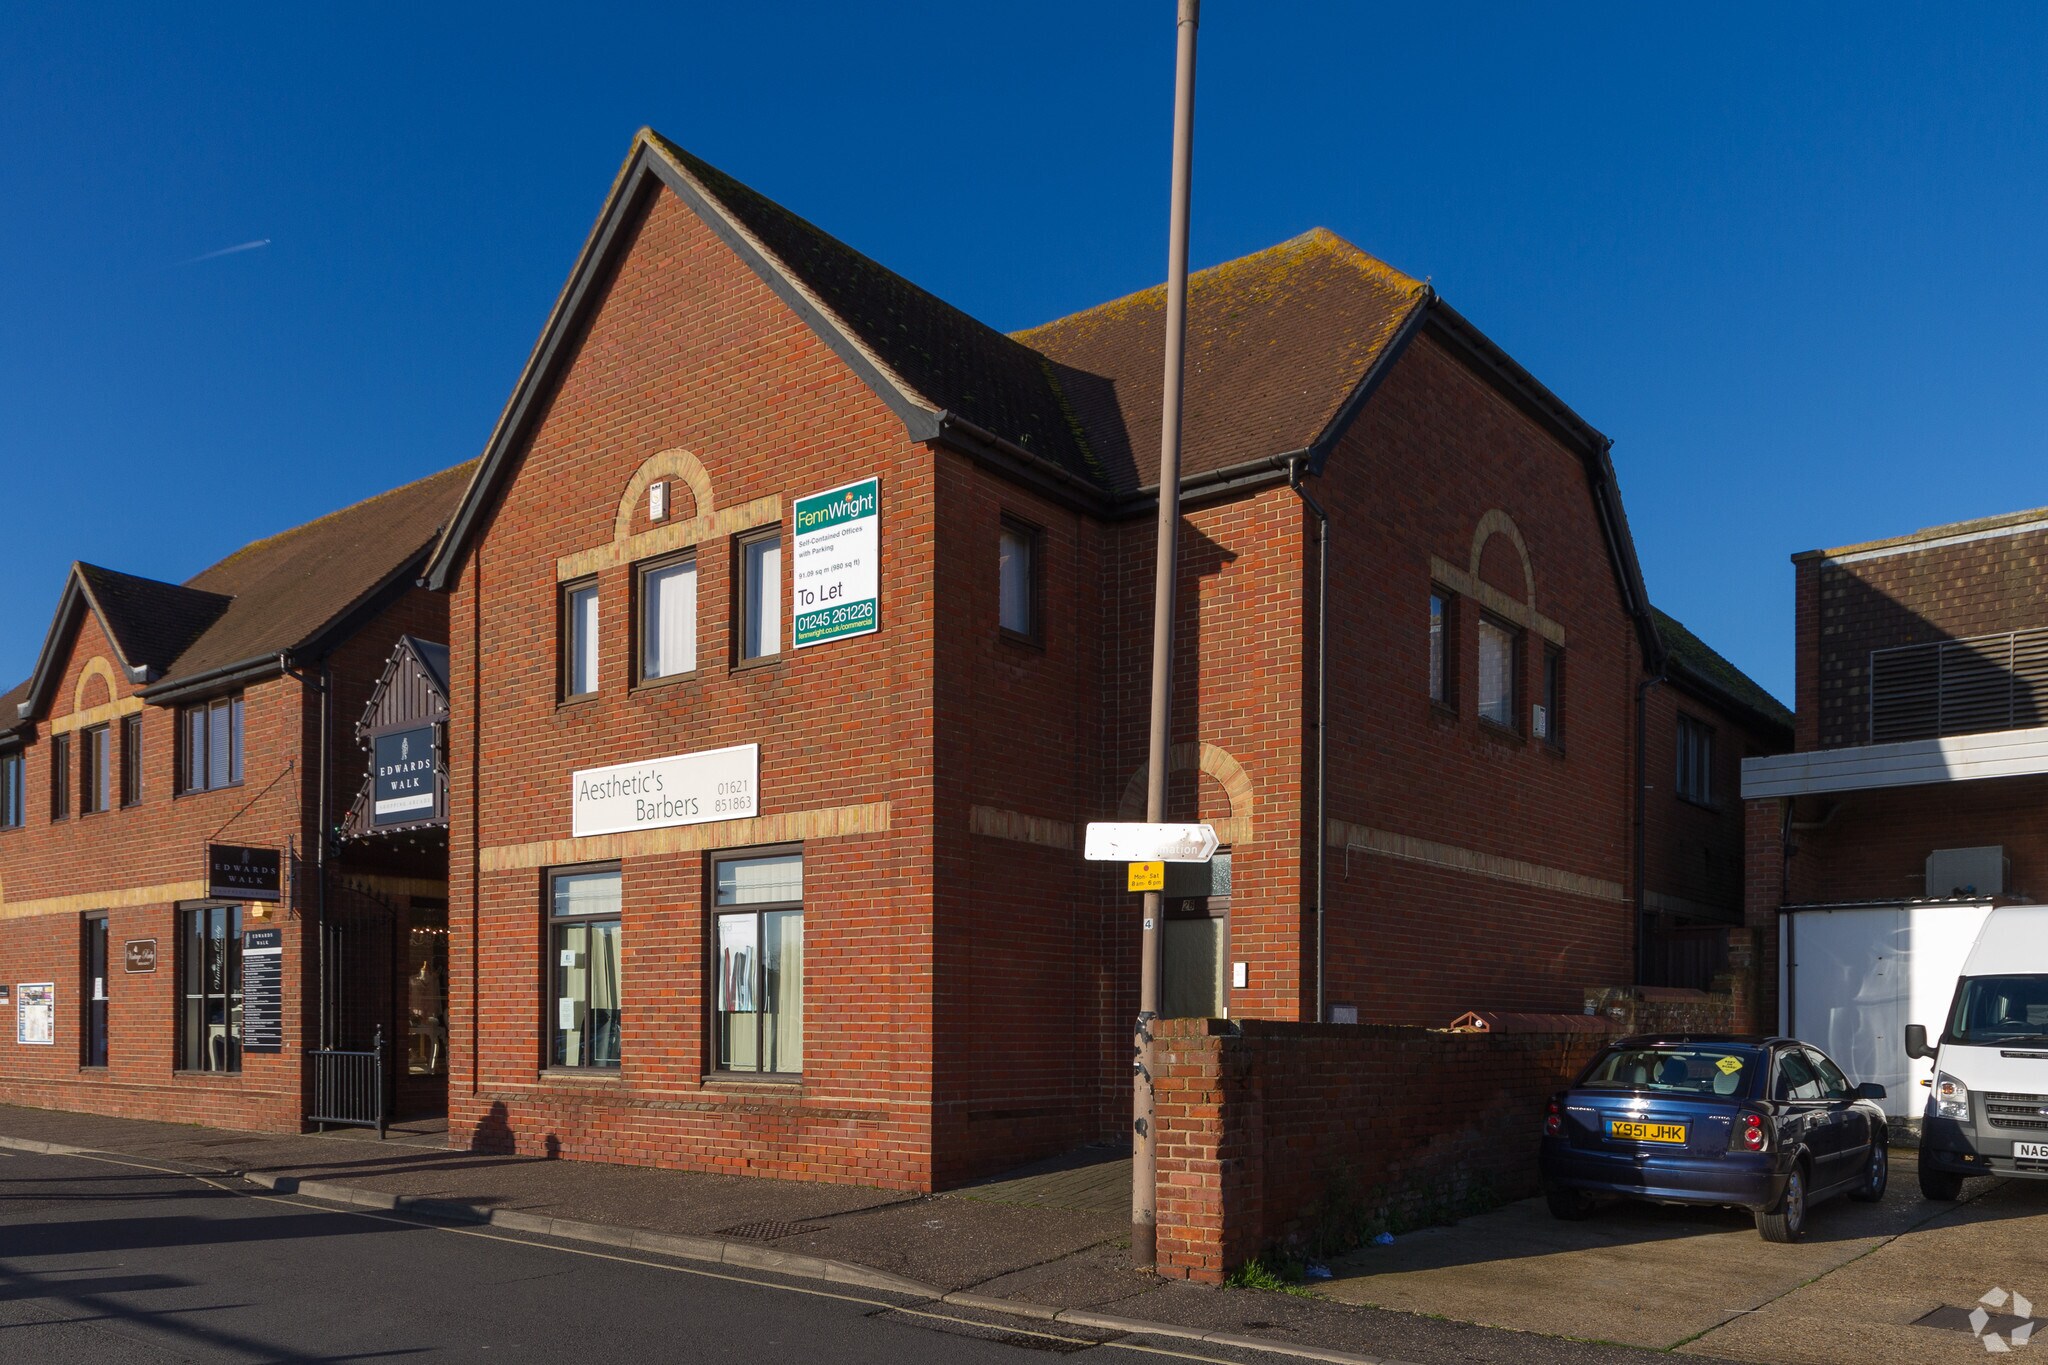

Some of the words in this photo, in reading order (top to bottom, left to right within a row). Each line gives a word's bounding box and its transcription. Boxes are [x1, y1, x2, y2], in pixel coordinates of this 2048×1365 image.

[798, 493, 874, 528] FennWright
[798, 531, 841, 548] Self-Contained
[841, 525, 863, 536] Offices
[798, 549, 811, 558] with
[811, 544, 834, 555] Parking
[798, 570, 814, 580] 91.09
[853, 558, 861, 566] ft)
[798, 588, 815, 606] To
[820, 581, 843, 601] Let
[798, 611, 830, 632] 01245
[831, 602, 873, 624] 261226
[798, 617, 873, 640] fennwright.co.uk/commercial
[380, 758, 431, 777] EDWARDS
[391, 777, 420, 791] WALK
[579, 770, 664, 802] Aesthetic's
[717, 779, 748, 796] 01621
[636, 794, 699, 821] Barbers
[714, 795, 752, 813] 851863
[215, 863, 277, 875] EDWARDS
[228, 875, 263, 884] WALK
[1144, 919, 1152, 928] 4
[1613, 1122, 1647, 1138] Y951
[1650, 1125, 1682, 1140] JHK
